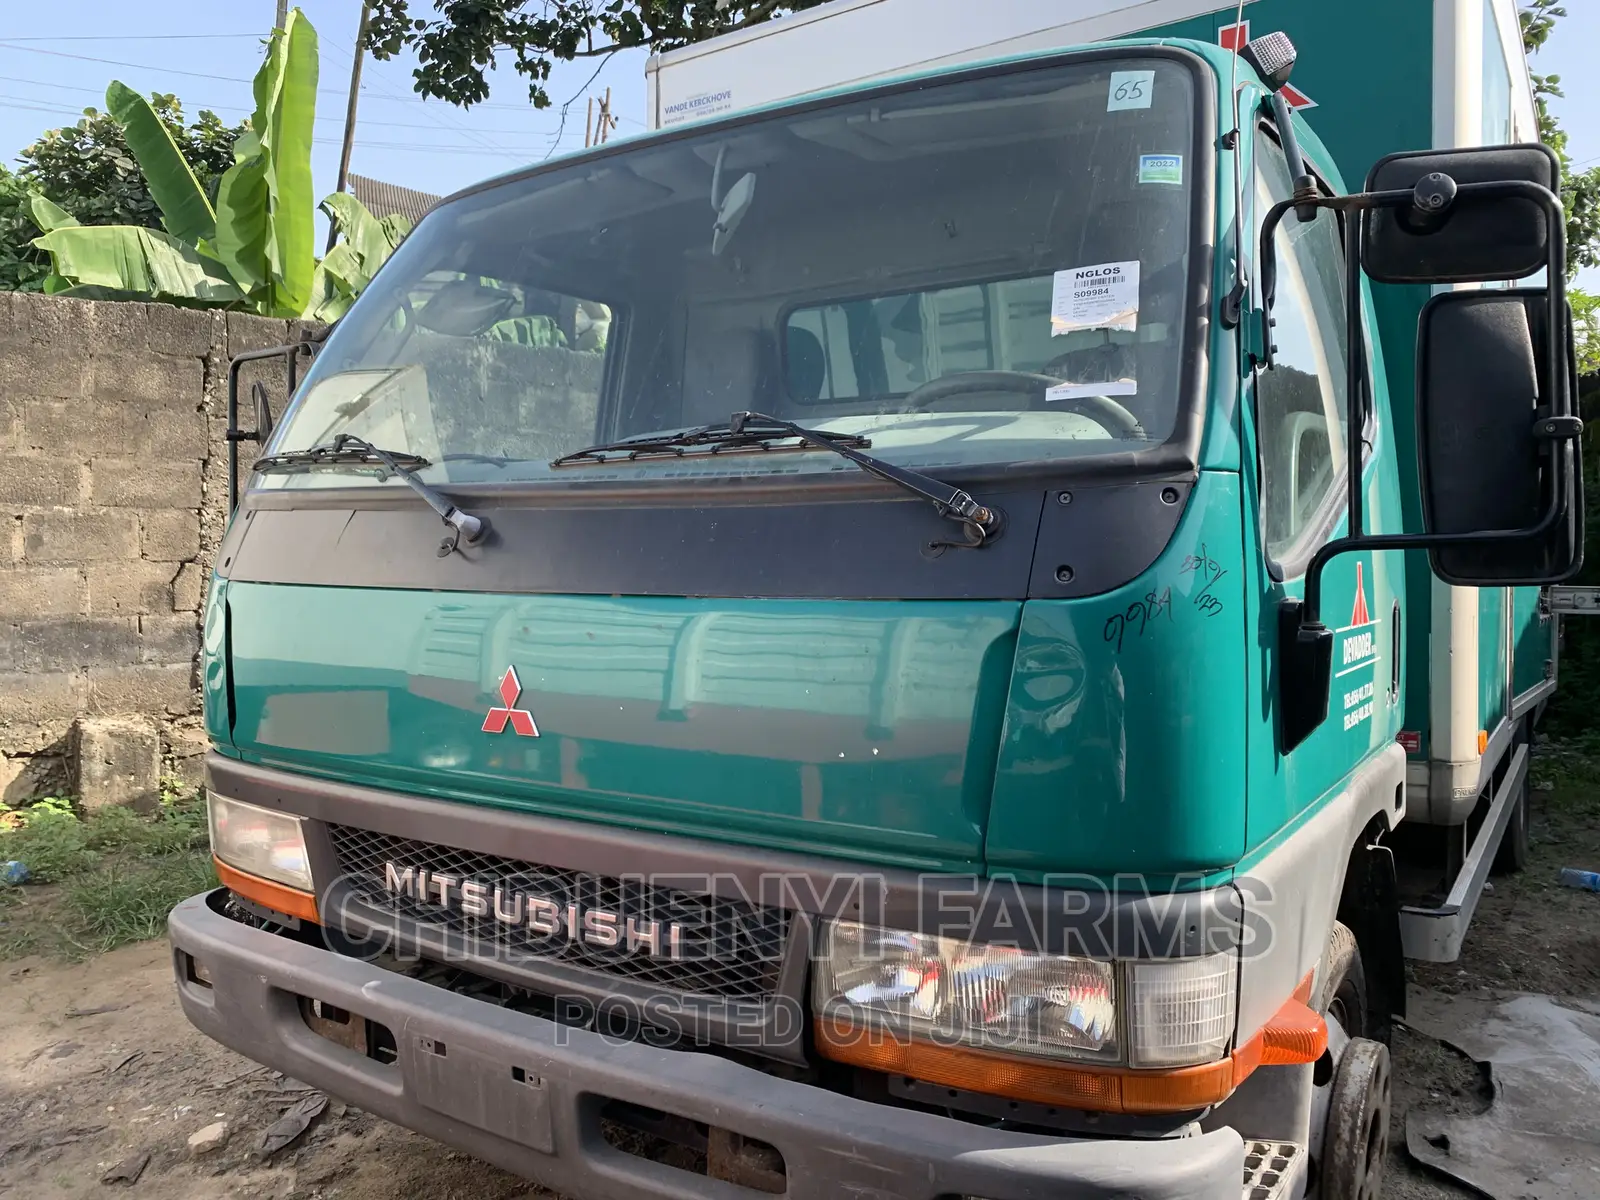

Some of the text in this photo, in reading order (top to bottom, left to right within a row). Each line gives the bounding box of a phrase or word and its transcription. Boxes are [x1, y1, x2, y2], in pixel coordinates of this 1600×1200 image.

[1114, 79, 1148, 101] 65
[664, 101, 688, 115] VANDE
[688, 90, 732, 109] KERCKHOVE
[1149, 160, 1174, 168] 2022
[1075, 266, 1121, 280] NGLOS
[1073, 287, 1110, 299] S09984
[384, 860, 683, 961] MITSUBISHI
